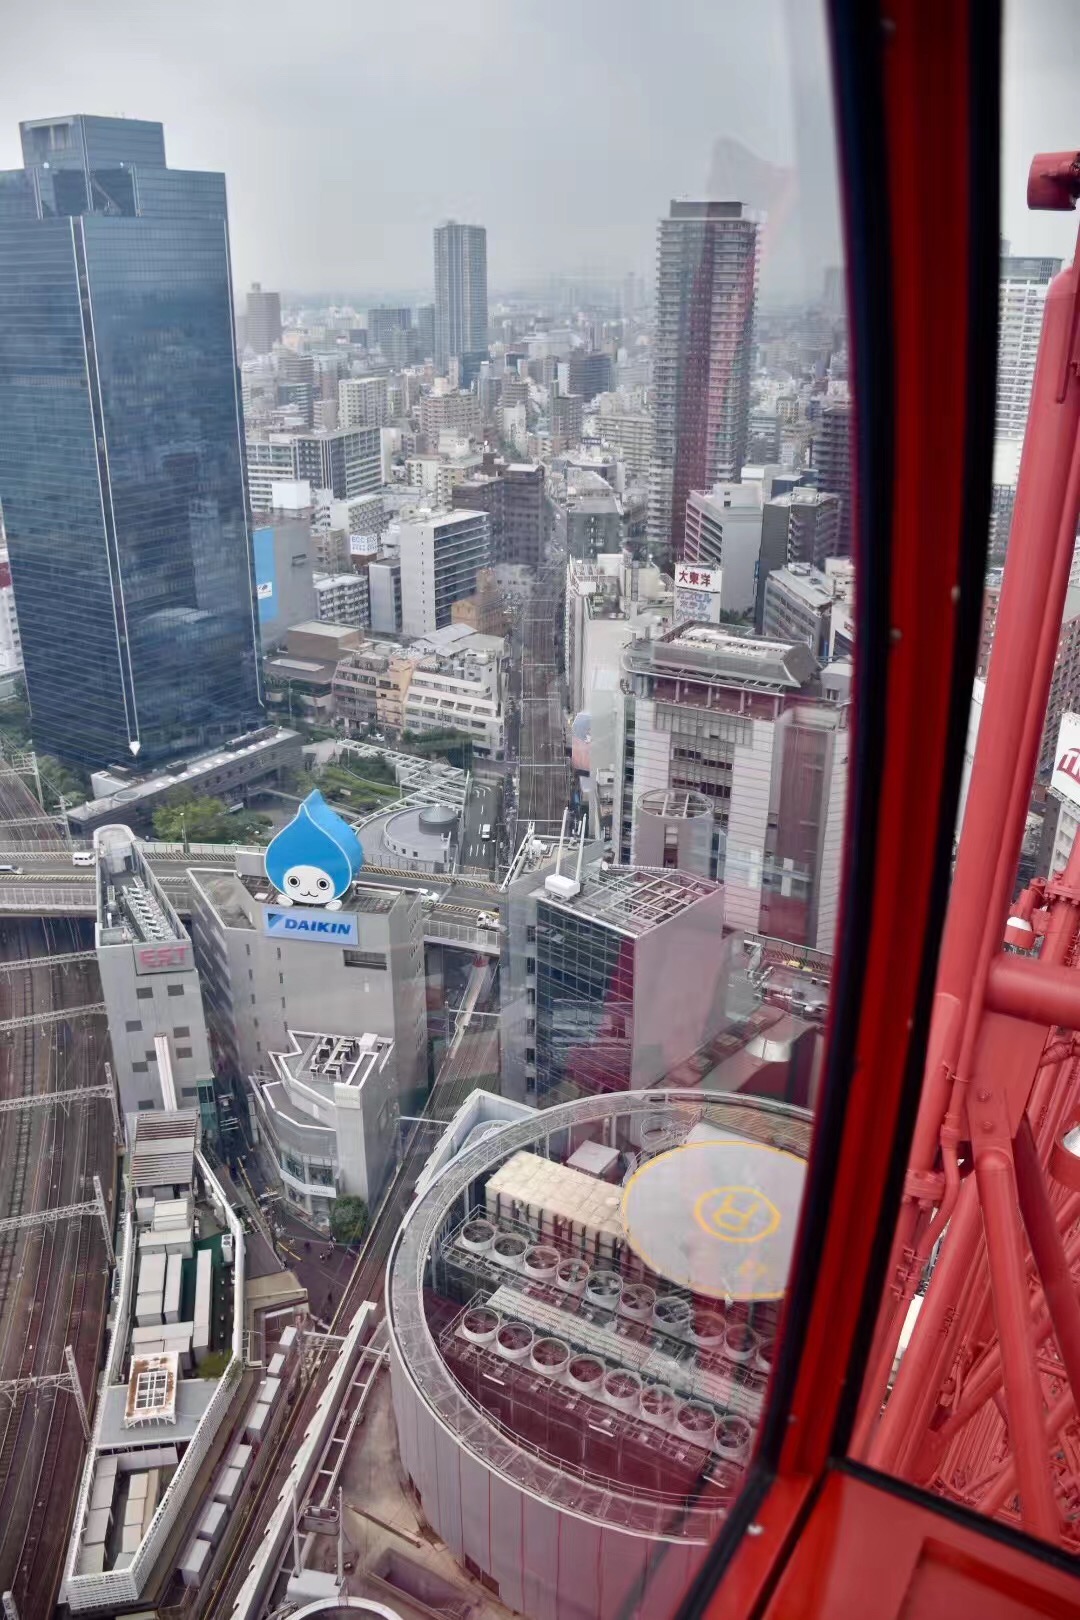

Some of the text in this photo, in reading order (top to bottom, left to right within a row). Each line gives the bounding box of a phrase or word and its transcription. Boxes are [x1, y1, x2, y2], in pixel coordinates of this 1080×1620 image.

[679, 570, 711, 587] 大東洋
[284, 917, 351, 935] DAIKIN
